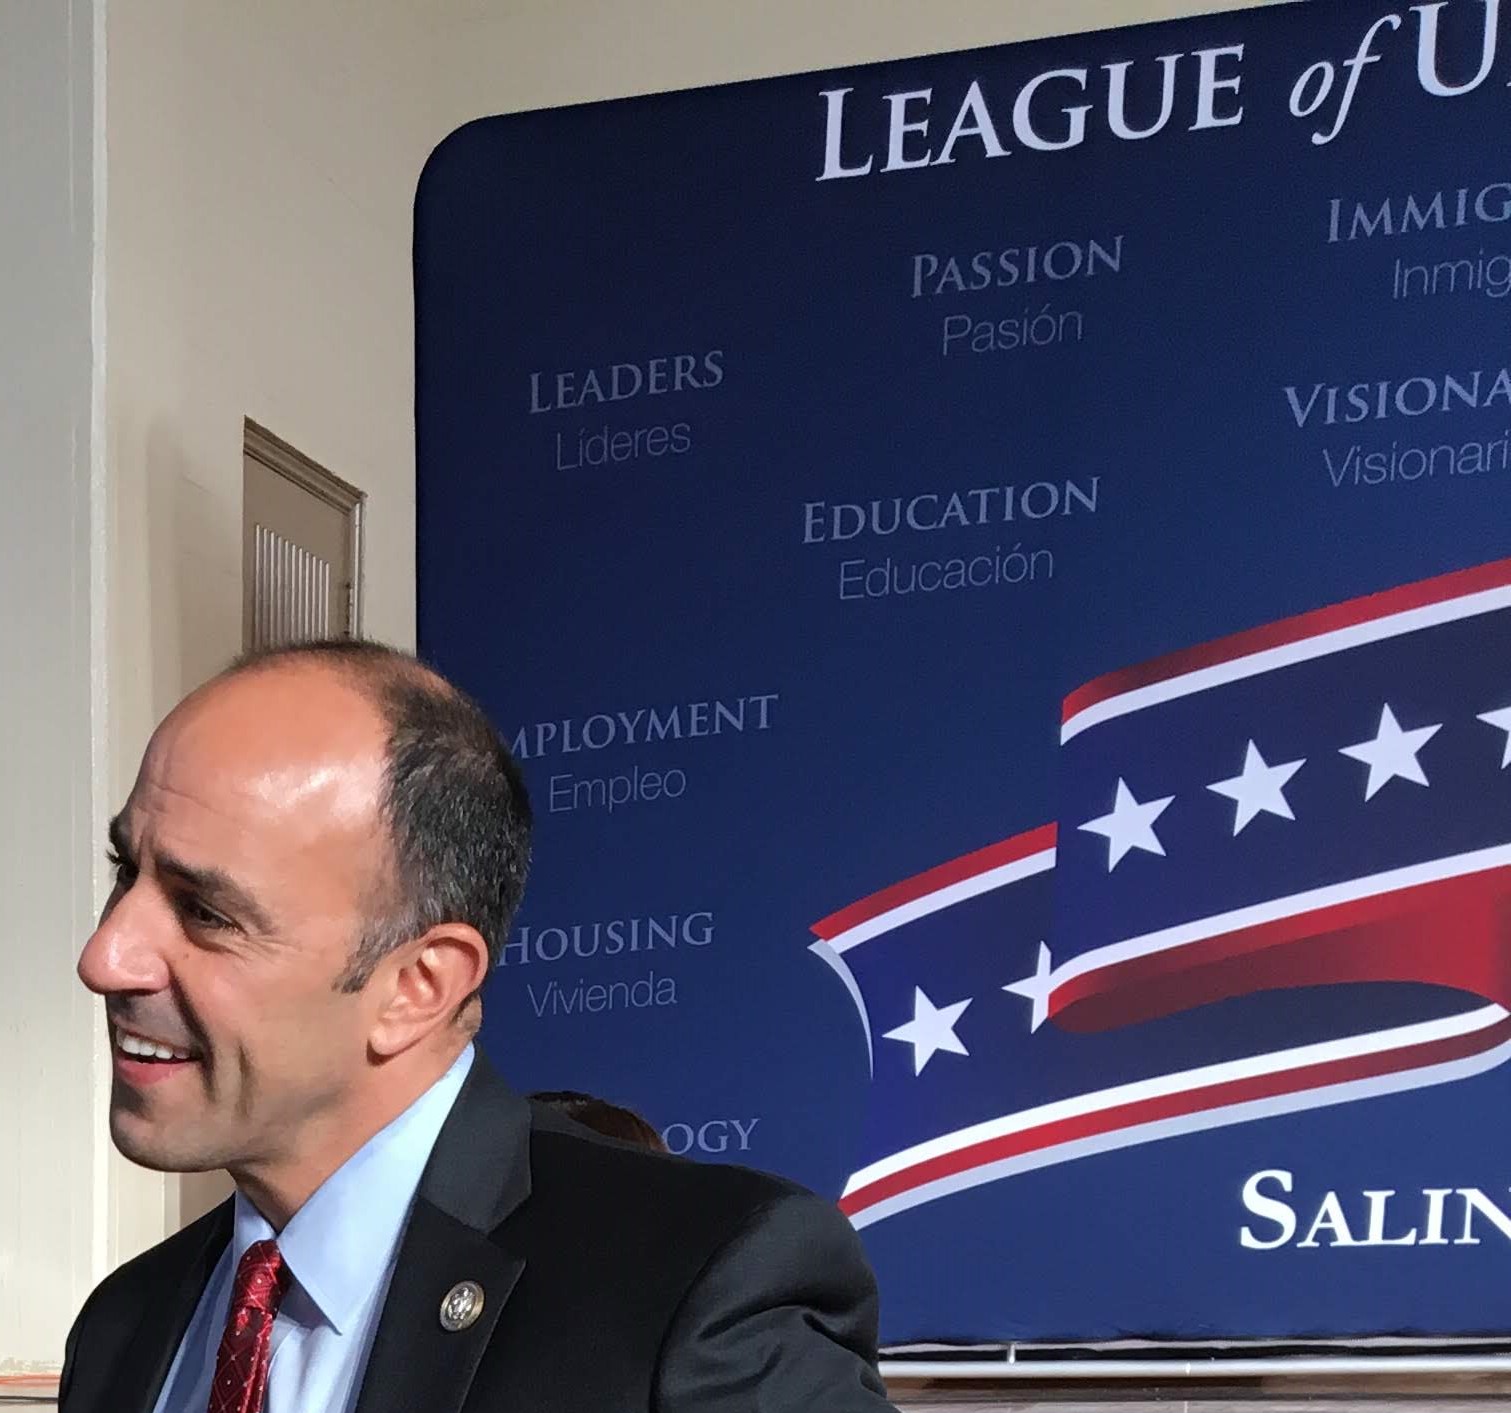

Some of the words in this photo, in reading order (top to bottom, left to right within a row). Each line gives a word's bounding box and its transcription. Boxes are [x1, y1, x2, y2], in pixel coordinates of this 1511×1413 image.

[814, 43, 1246, 182] LEAGUE
[1289, 14, 1402, 145] of
[1408, 0, 1511, 97] U
[911, 235, 1125, 299] PASSION
[942, 304, 1084, 356] Pasión
[528, 350, 724, 414] LEADERS
[556, 422, 692, 471] Líderes
[1322, 429, 1510, 487] Visionari
[801, 476, 1102, 545] EDUCATION
[838, 544, 1055, 600] Educación
[510, 694, 780, 760] MPLOYMENT
[549, 765, 687, 813] Empleo
[496, 912, 715, 967] HOUSING
[526, 970, 678, 1018] Vivienda
[661, 1118, 761, 1156] OGY
